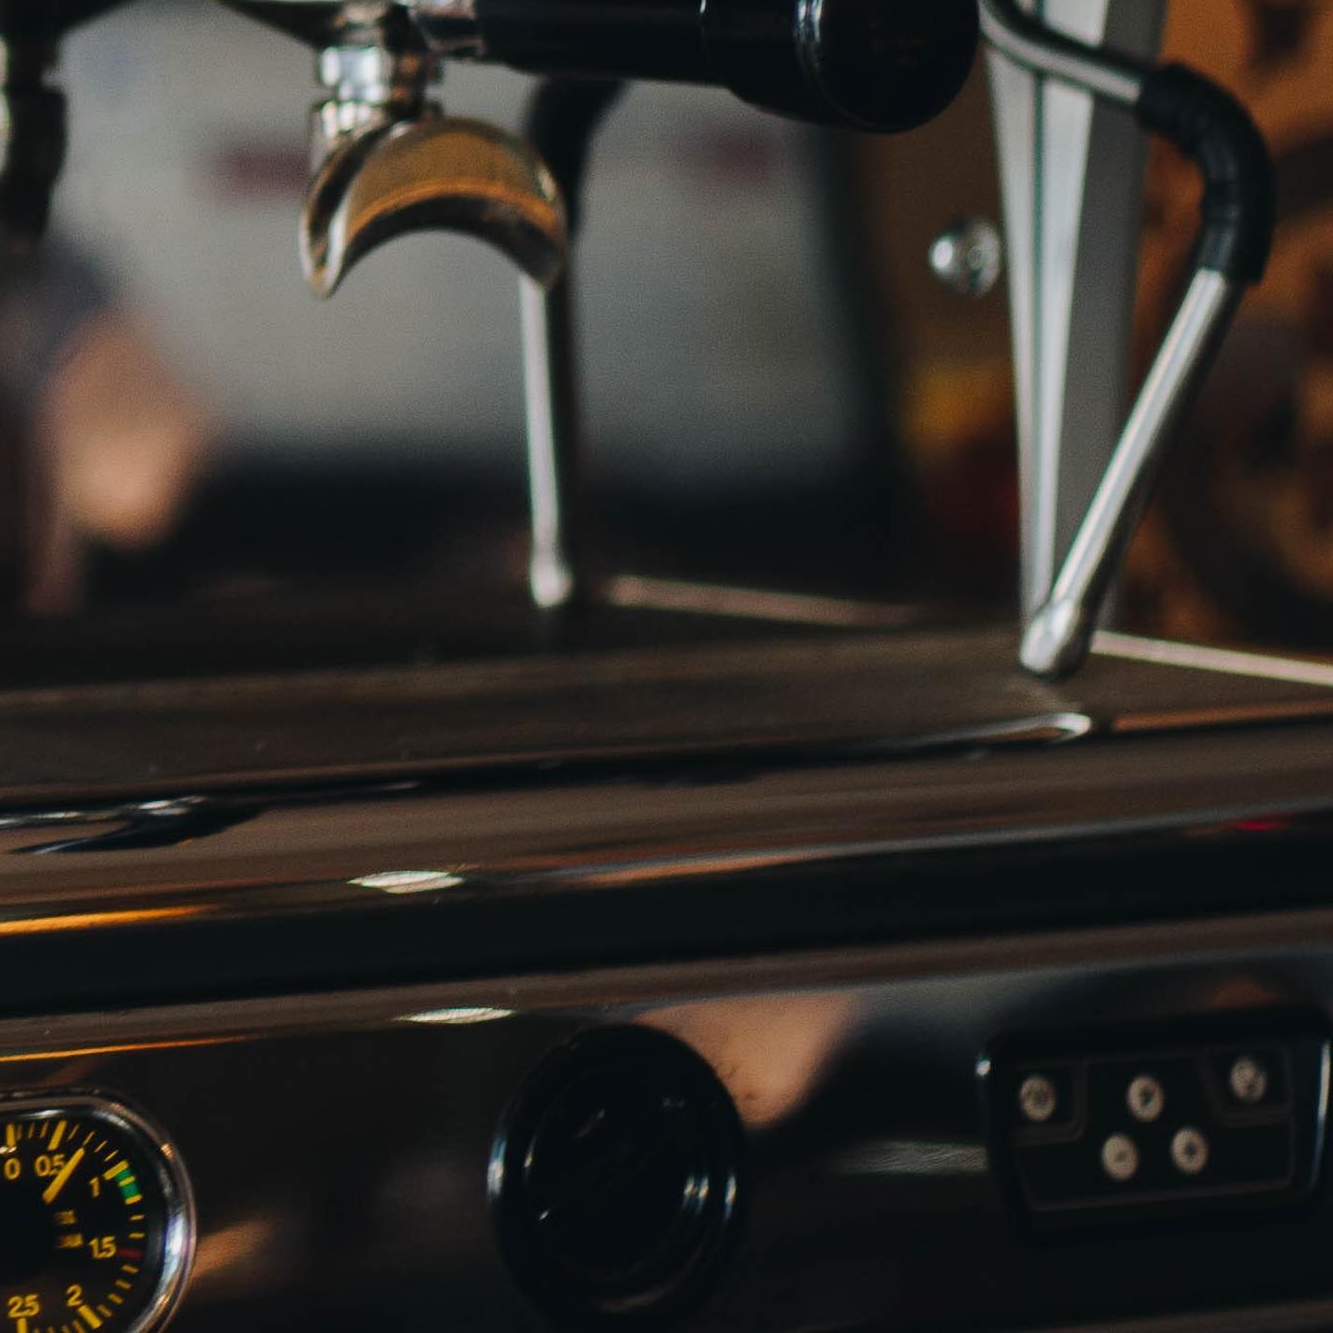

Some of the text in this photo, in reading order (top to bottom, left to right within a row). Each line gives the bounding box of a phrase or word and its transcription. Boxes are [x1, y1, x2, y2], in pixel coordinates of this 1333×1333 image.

[4, 1158, 21, 1180] 0
[89, 1177, 100, 1197] 1
[66, 1283, 83, 1308] 2
